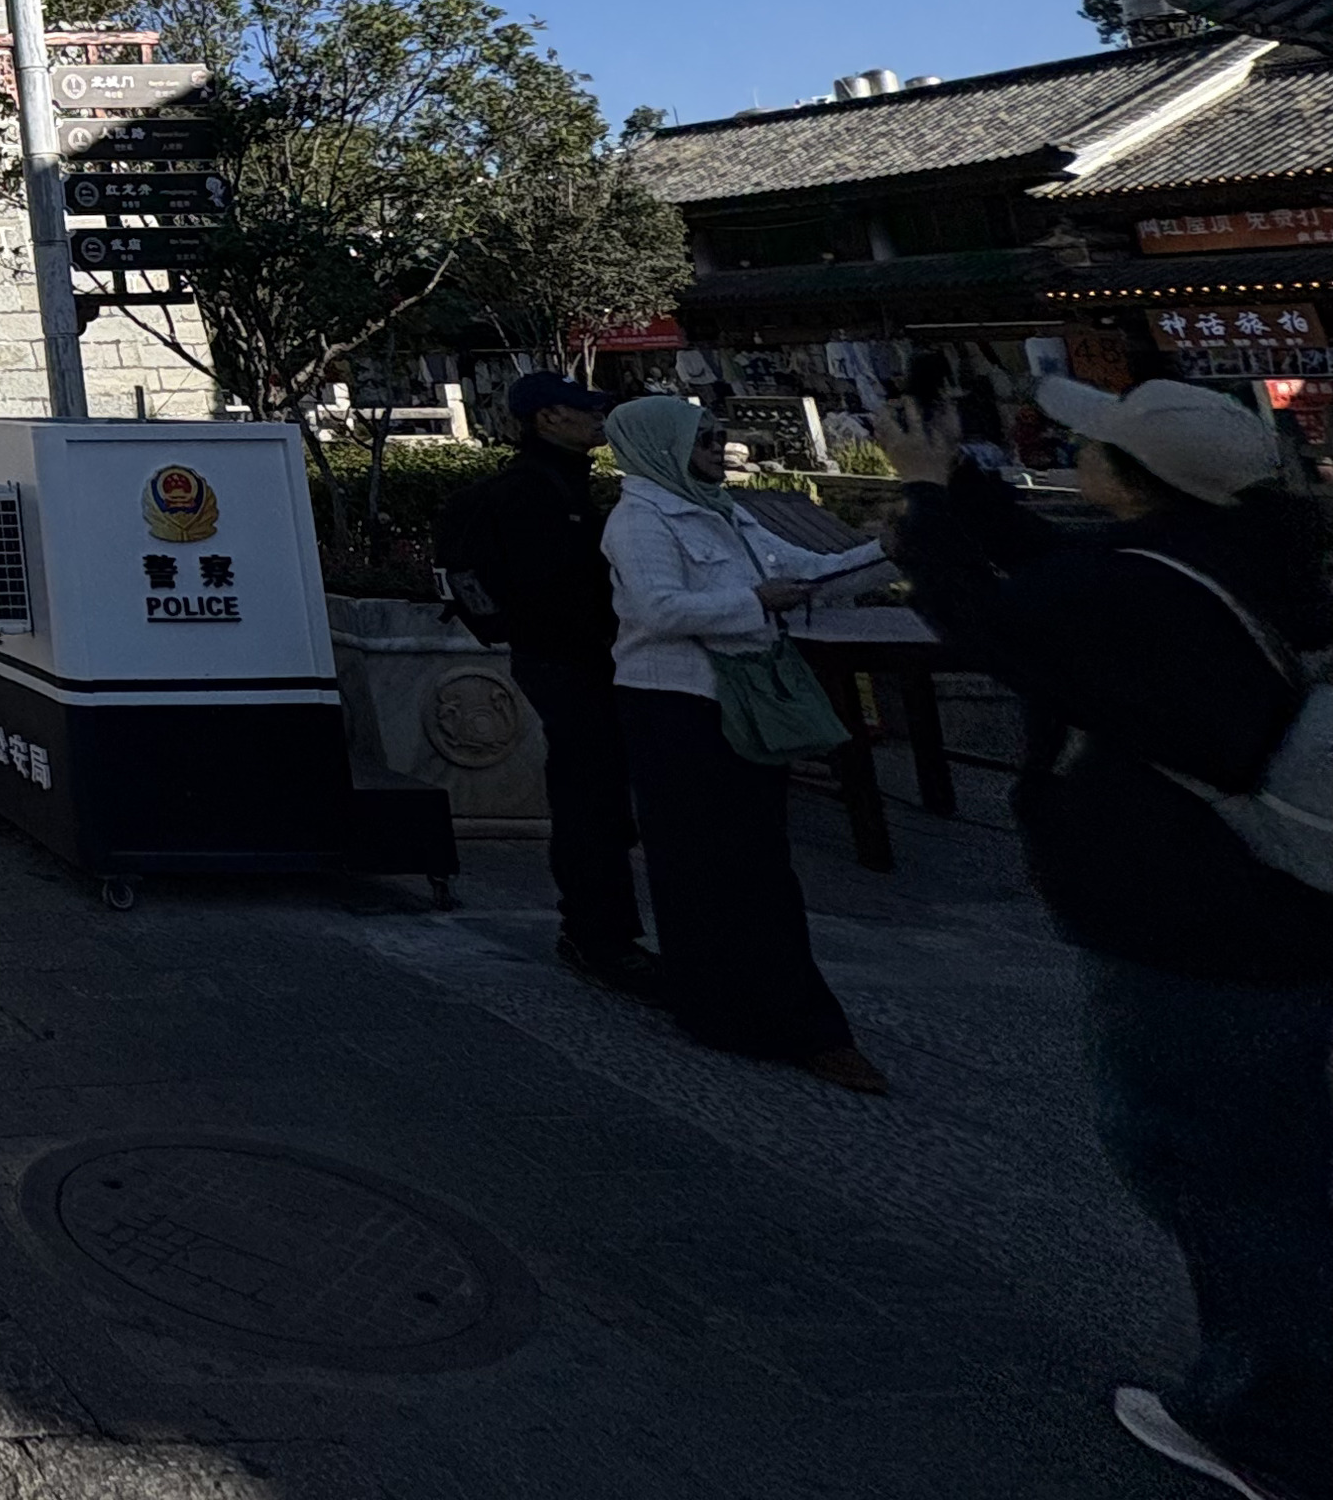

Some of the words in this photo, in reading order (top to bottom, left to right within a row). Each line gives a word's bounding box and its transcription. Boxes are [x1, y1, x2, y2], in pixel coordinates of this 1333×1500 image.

[100, 127, 147, 141] 人民路
[1139, 217, 1233, 239] 网红屋顶
[1247, 208, 1333, 230] 免费打
[1158, 310, 1309, 338] 神话旅拍
[142, 554, 235, 589] 警察
[146, 596, 240, 616] POLICE
